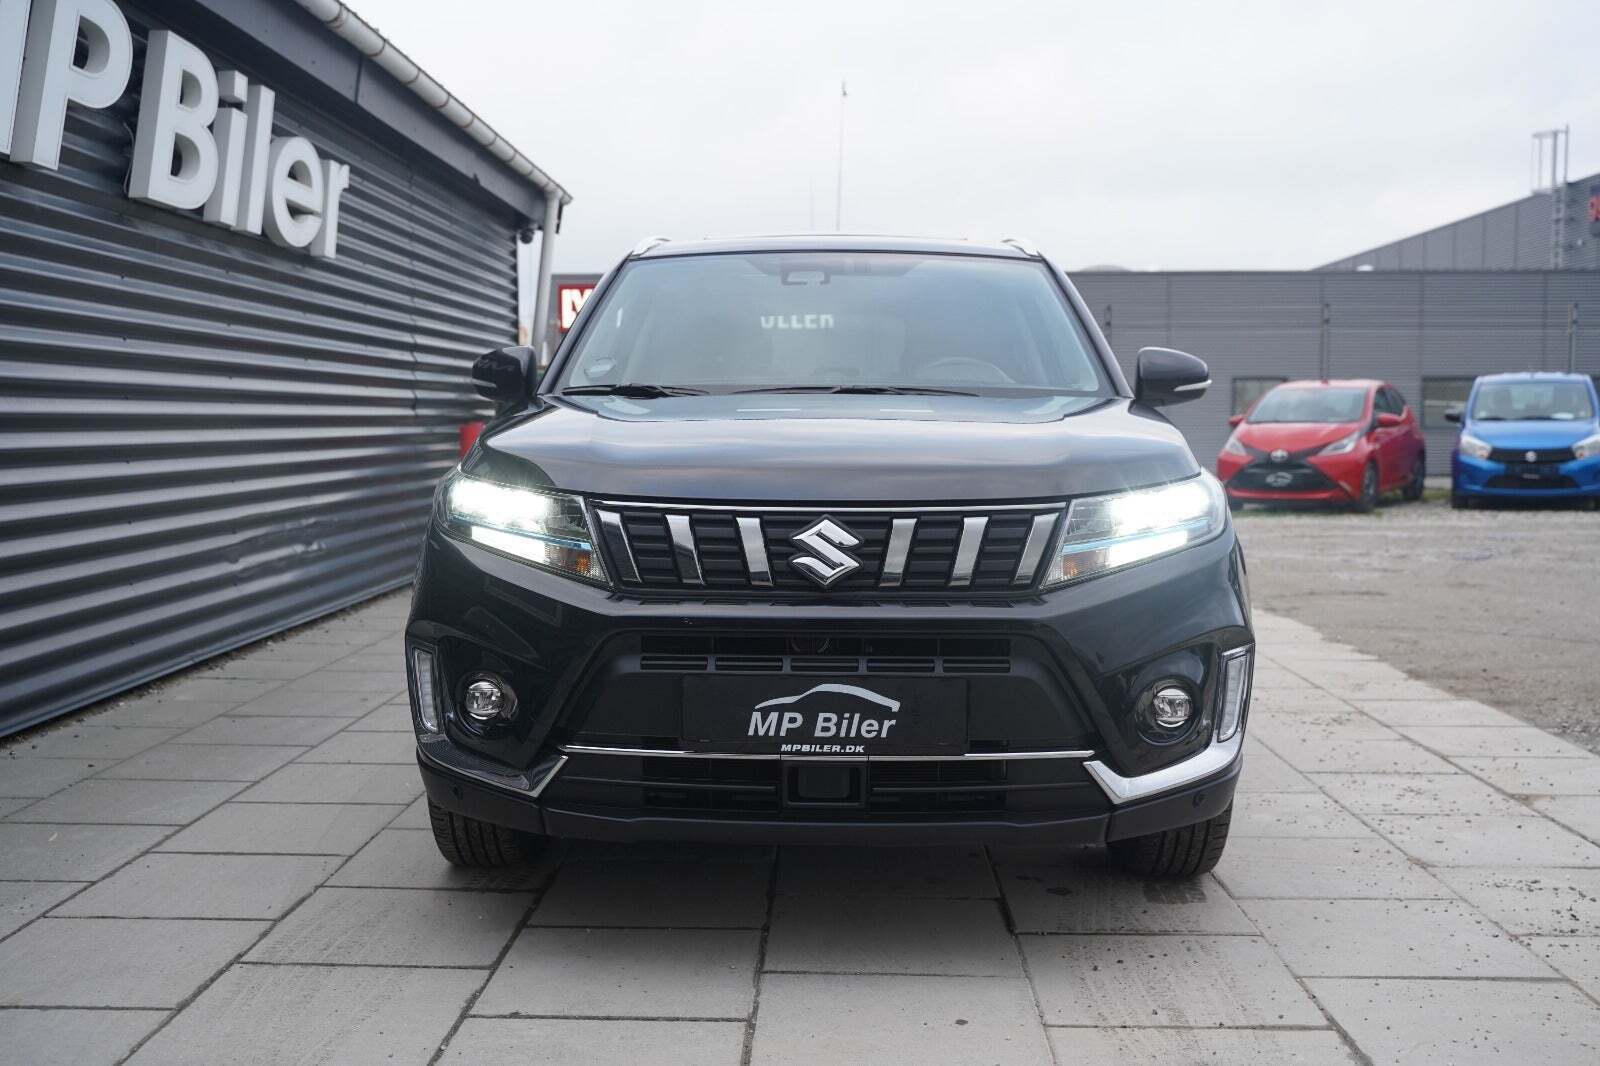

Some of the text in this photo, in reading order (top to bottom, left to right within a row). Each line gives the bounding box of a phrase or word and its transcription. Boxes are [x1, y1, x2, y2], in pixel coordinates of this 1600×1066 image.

[0, 0, 349, 259] P Biler
[748, 711, 896, 738] MP Biler
[780, 744, 865, 753] MPBILER.DK
